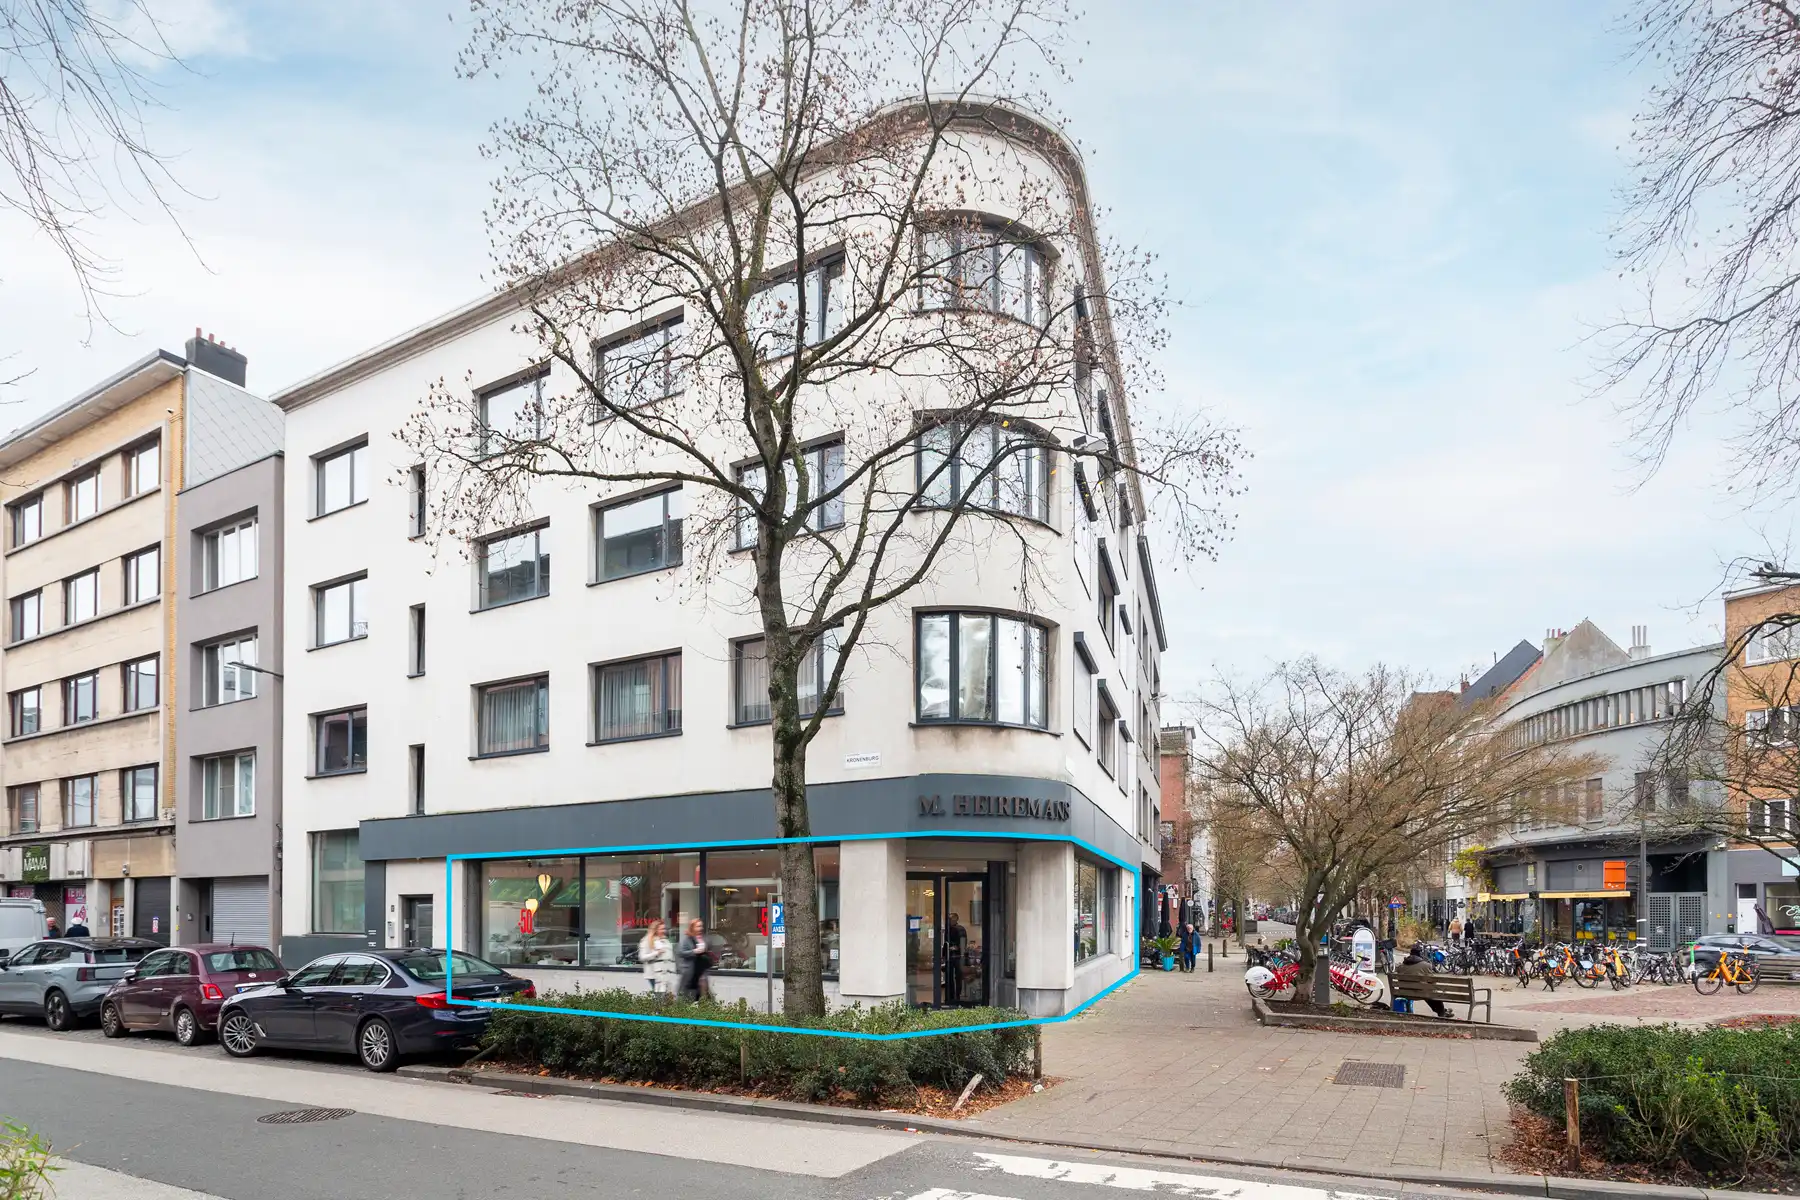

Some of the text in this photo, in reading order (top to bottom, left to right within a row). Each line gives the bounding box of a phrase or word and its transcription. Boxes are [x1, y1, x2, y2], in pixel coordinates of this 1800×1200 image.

[846, 755, 880, 764] KRONENBURG
[917, 794, 1071, 822] M. HEIREMANS
[757, 907, 769, 937] -5
[772, 905, 781, 923] P
